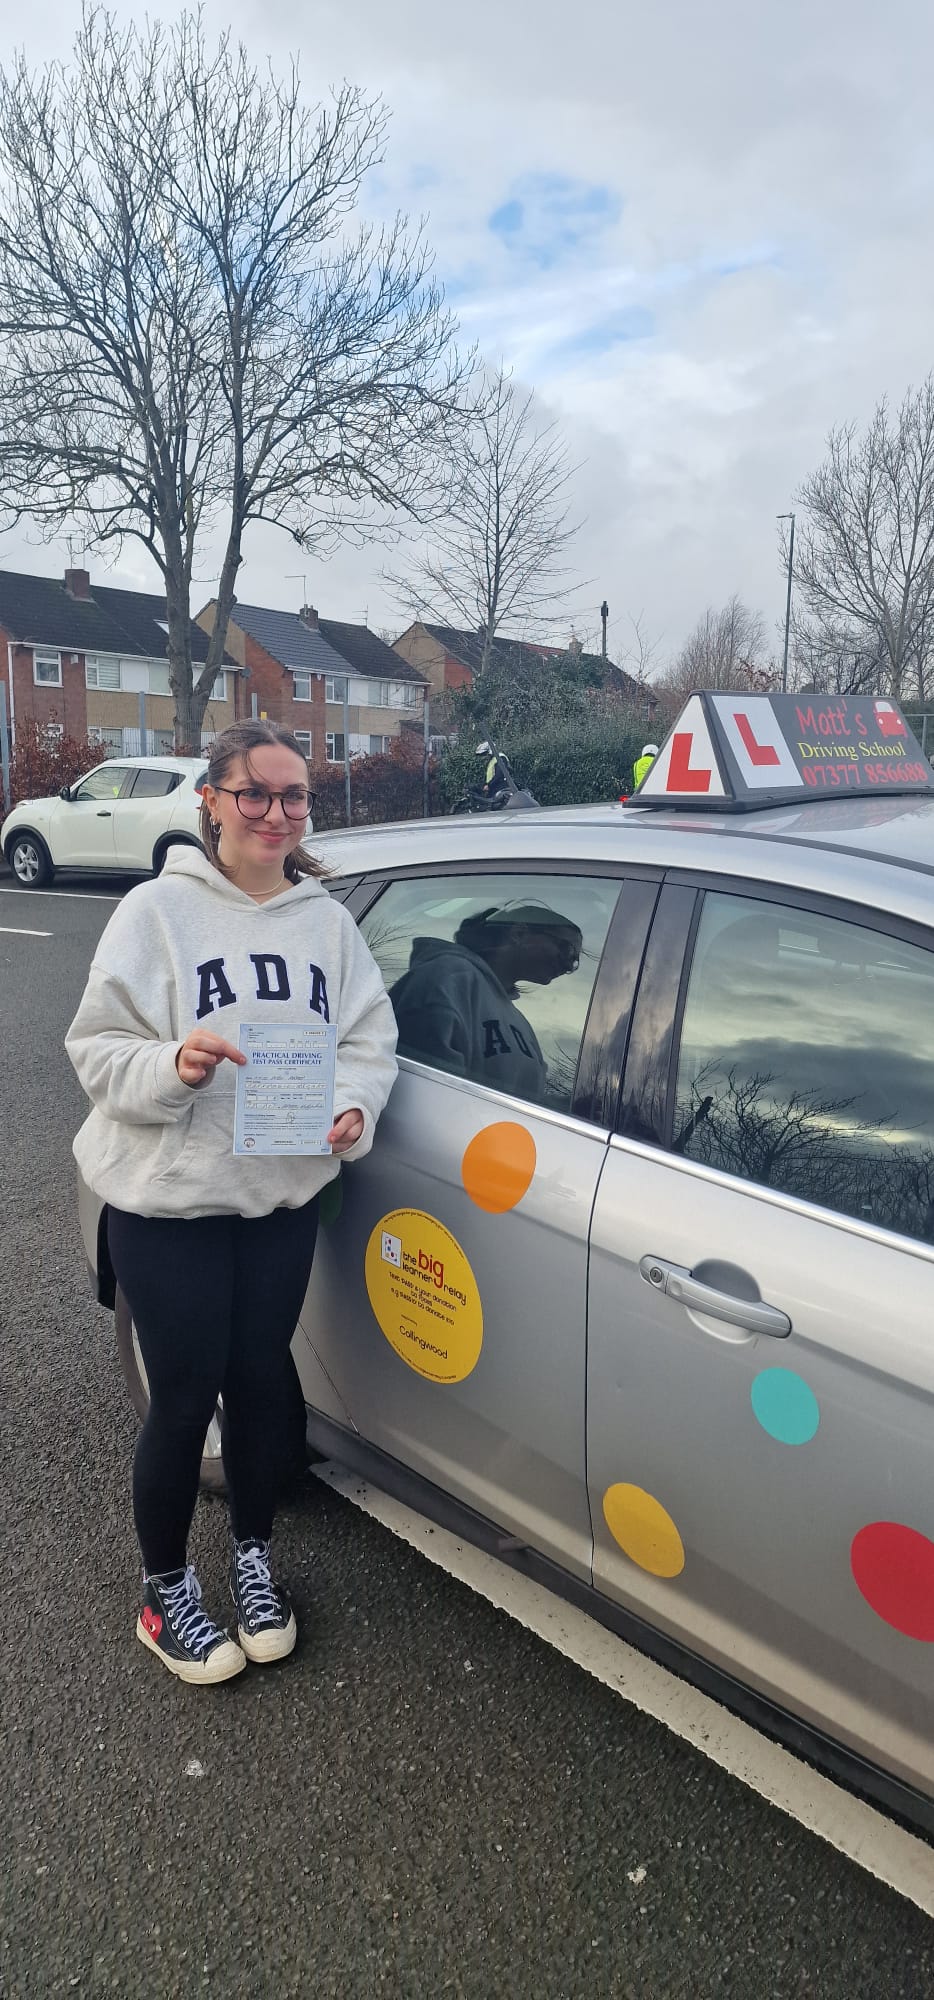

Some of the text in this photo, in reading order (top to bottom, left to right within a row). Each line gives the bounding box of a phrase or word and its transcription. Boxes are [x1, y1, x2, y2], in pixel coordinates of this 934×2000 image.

[795, 699, 867, 737] Matt's
[733, 713, 781, 766] L
[797, 741, 907, 761] Driving School
[665, 732, 712, 792] L
[802, 762, 929, 788] 07377 856688
[402, 1248, 444, 1289] the big
[402, 1262, 467, 1306] learner relay
[432, 1294, 457, 1312] donation
[399, 1325, 448, 1360] Collingwood
